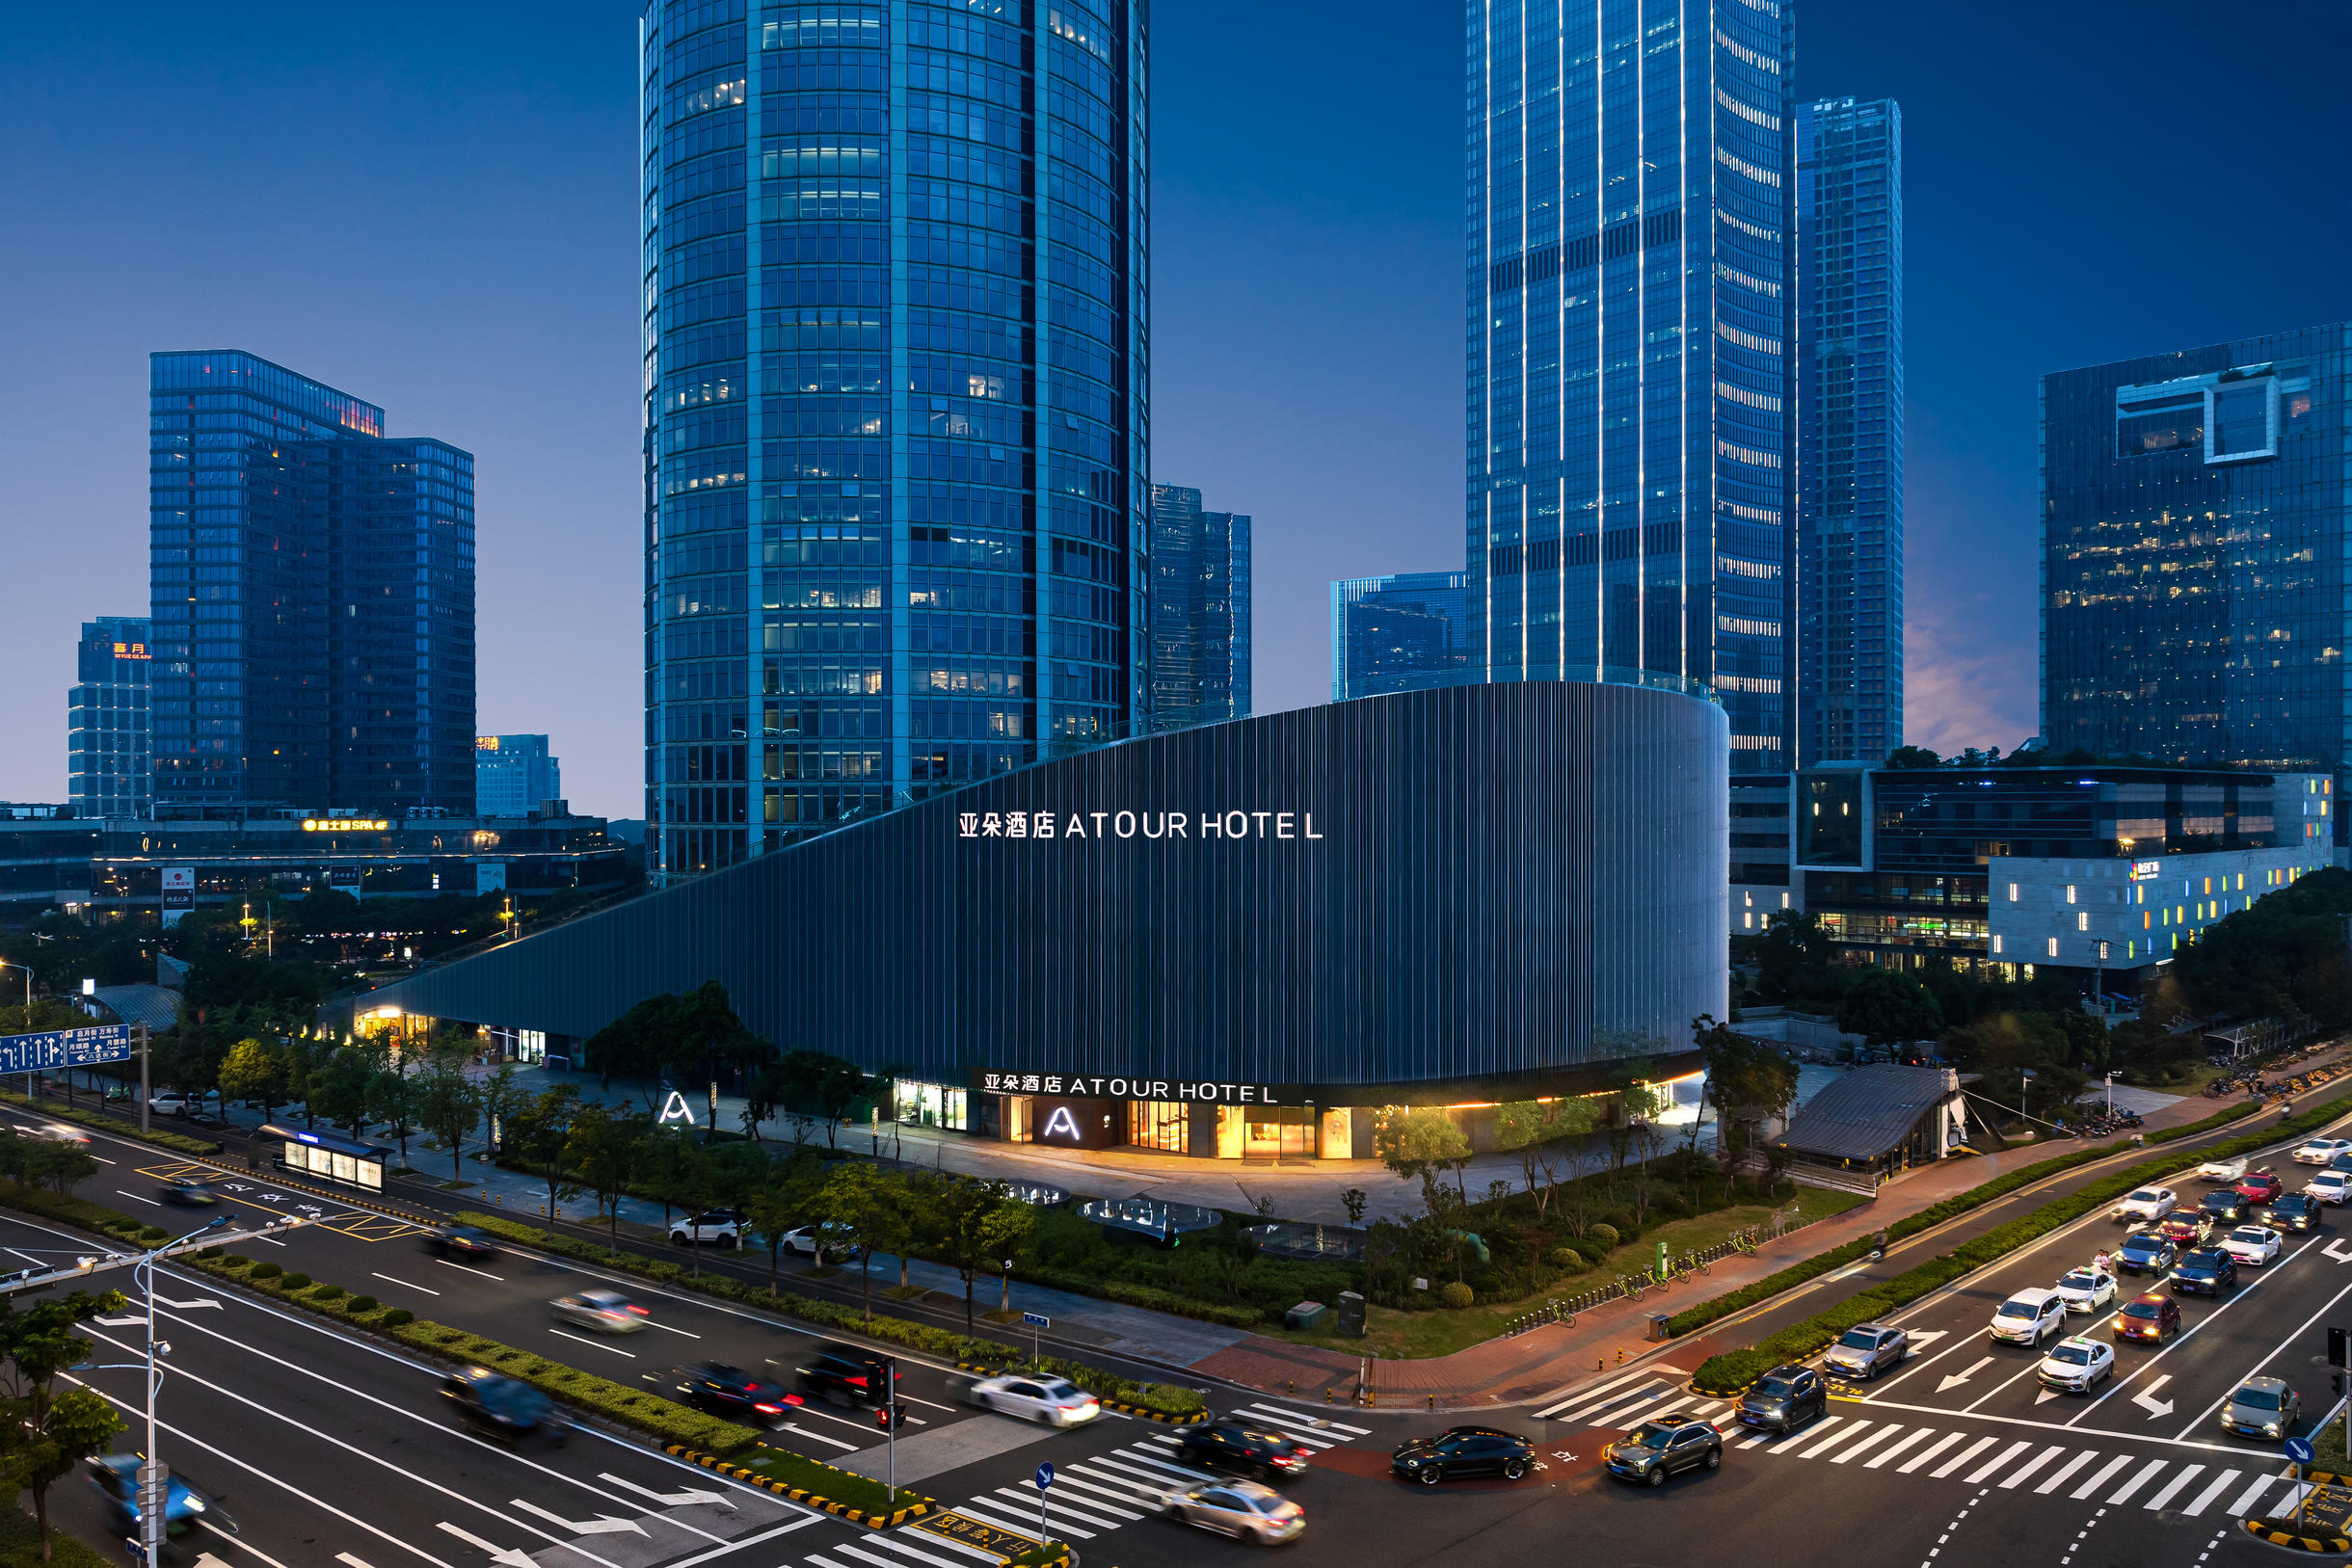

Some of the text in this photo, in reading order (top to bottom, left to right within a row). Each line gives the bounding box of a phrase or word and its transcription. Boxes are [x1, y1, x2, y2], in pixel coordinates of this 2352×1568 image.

[959, 811, 1323, 839] 亚朵酒店 ATOUR HOTEL
[984, 1073, 1278, 1103] 亚朵酒店 ATOUR HOTEL
[1044, 1105, 1081, 1141] A
